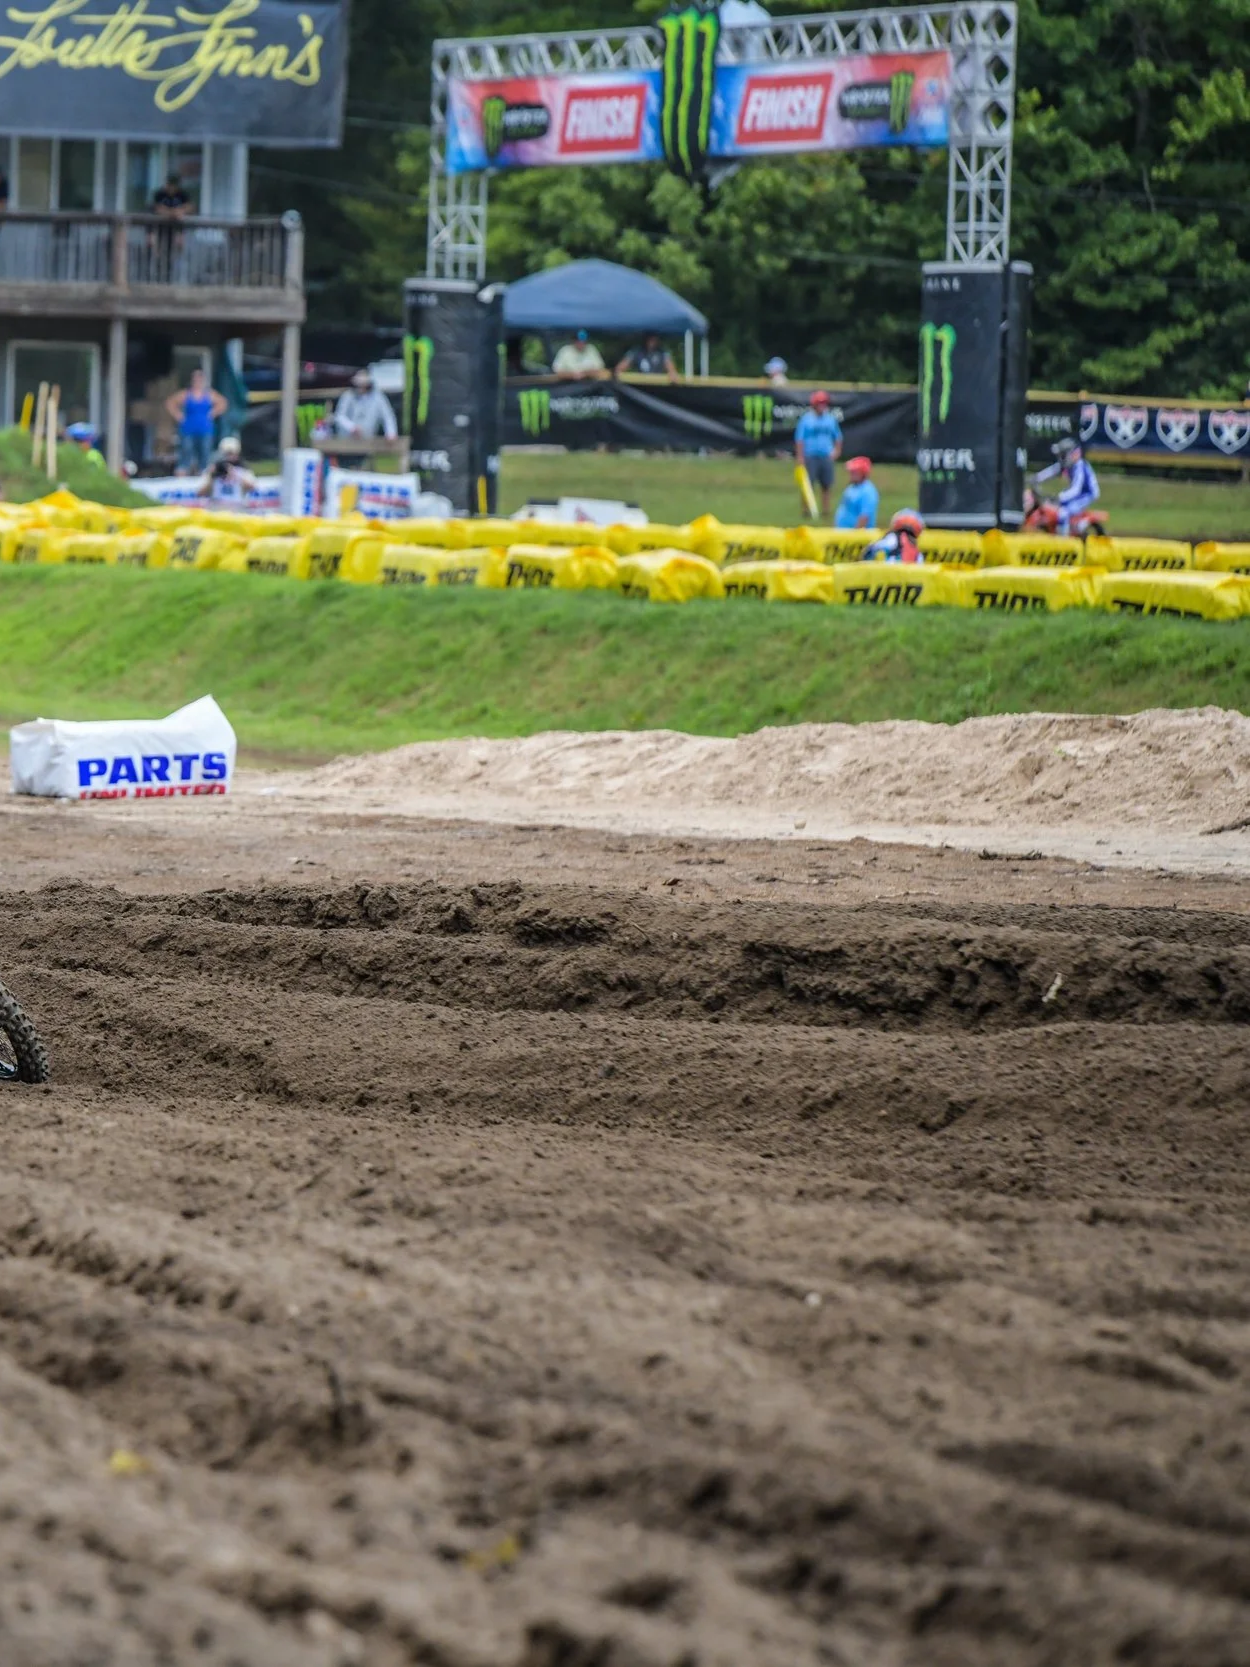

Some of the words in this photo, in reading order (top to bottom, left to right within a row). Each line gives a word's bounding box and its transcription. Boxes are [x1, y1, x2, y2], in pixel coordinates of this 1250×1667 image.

[564, 94, 638, 142] FINISH
[742, 84, 824, 133] FINISH
[823, 543, 864, 563] THO
[843, 582, 924, 605] THOR
[77, 751, 228, 787] PARTS
